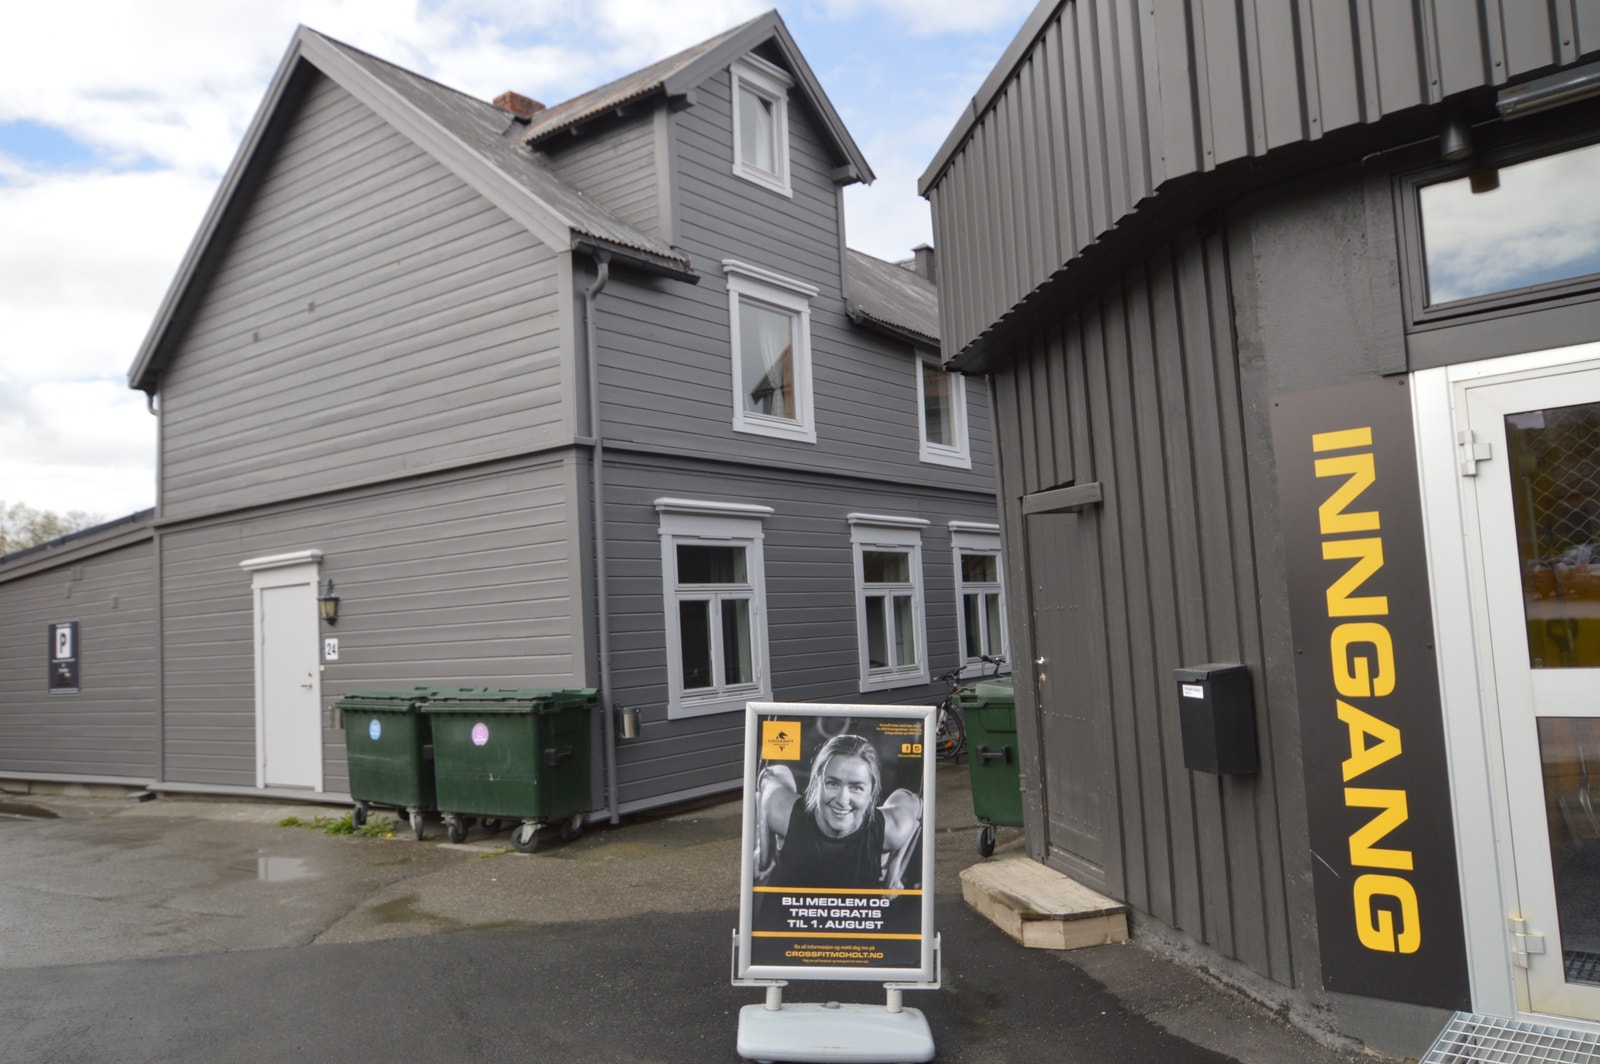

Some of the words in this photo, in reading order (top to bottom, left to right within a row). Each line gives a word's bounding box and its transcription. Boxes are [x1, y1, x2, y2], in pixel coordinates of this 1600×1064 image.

[327, 642, 336, 656] 24
[1312, 426, 1421, 954] INNGANG
[782, 897, 803, 905] BLI
[806, 897, 867, 907] MEDLEM
[869, 898, 890, 907] OG
[789, 908, 828, 917] TREN
[830, 909, 882, 918] GRATIS
[787, 919, 808, 928] TIL
[810, 920, 823, 928] 1.
[825, 920, 884, 929] AUGUST
[785, 950, 884, 959] CROSSFITMOHOLT.NO
